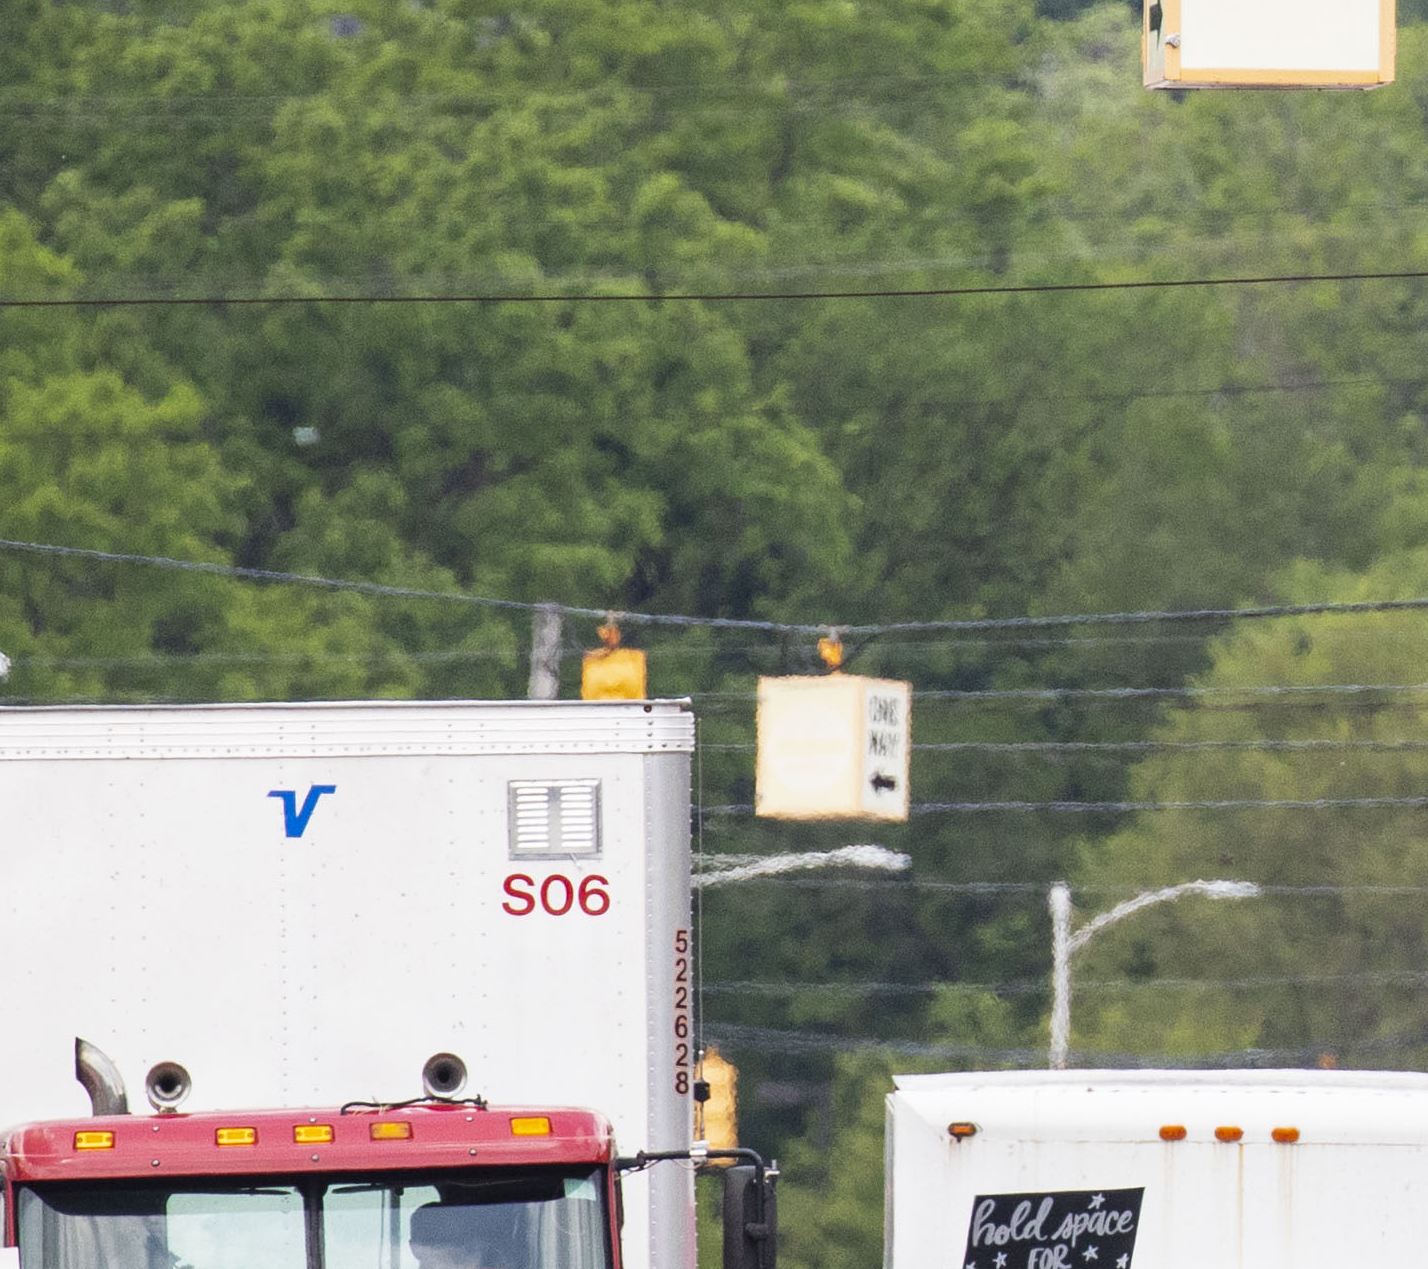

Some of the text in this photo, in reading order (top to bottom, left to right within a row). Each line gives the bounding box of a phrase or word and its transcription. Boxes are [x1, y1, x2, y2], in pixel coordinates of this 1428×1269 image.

[675, 929, 690, 1095] 522628
[972, 1197, 1134, 1248] hold space
